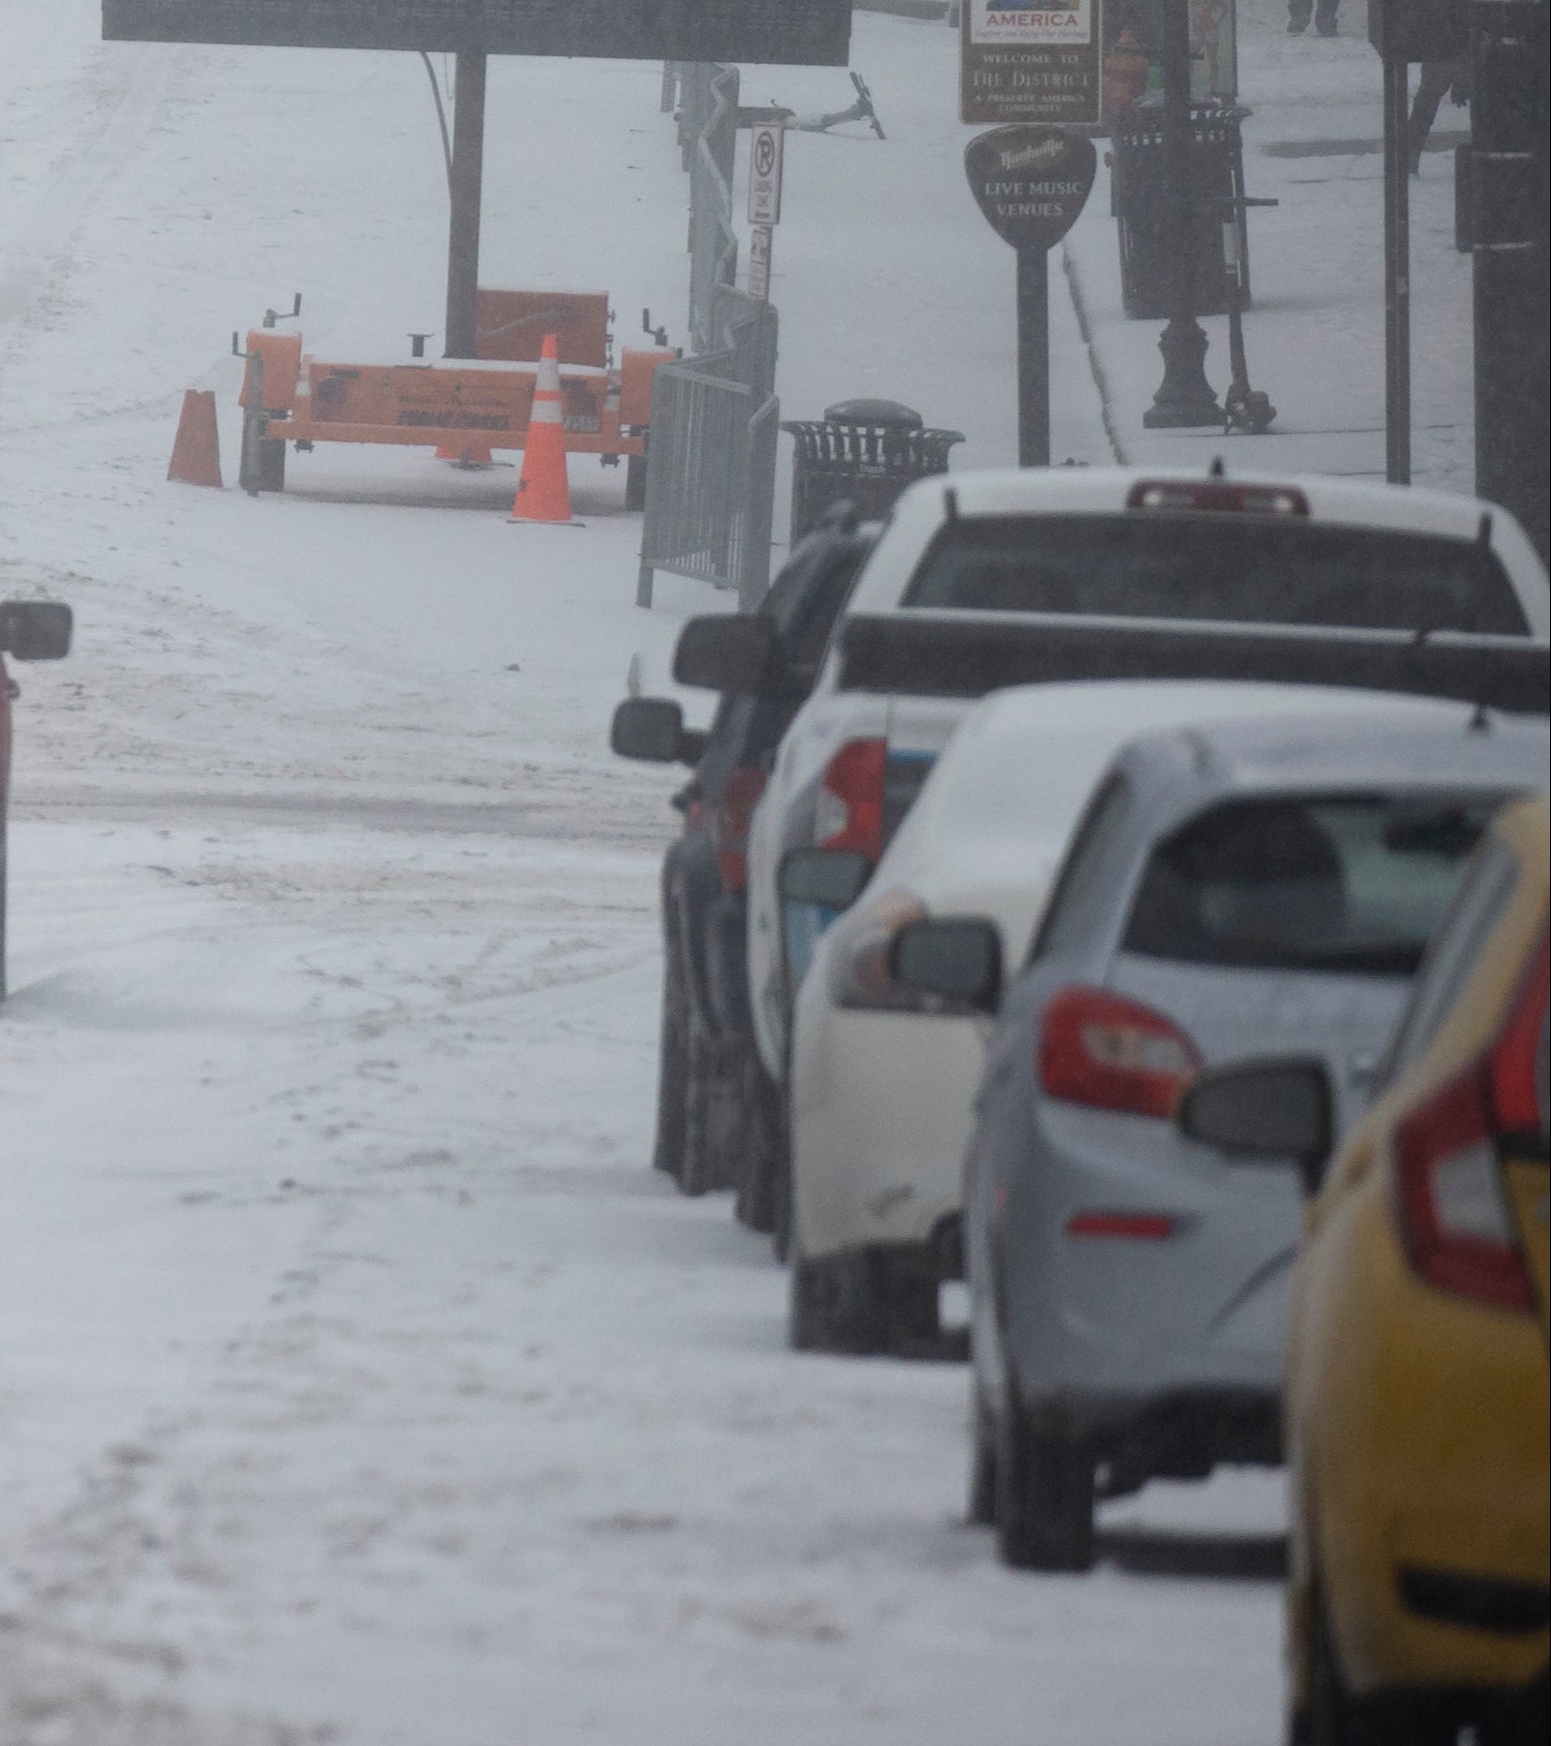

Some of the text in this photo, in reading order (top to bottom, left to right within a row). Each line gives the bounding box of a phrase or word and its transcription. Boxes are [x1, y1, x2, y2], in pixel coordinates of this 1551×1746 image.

[986, 13, 1079, 27] AMERICA
[983, 53, 1079, 65] WELCOME TO
[973, 71, 1091, 87] THE DISTRICT
[987, 94, 1036, 103] PRESERVE
[1041, 94, 1085, 103] AMERICA
[985, 181, 1083, 196] LIVE MUSIC
[997, 203, 1064, 216] VENUES
